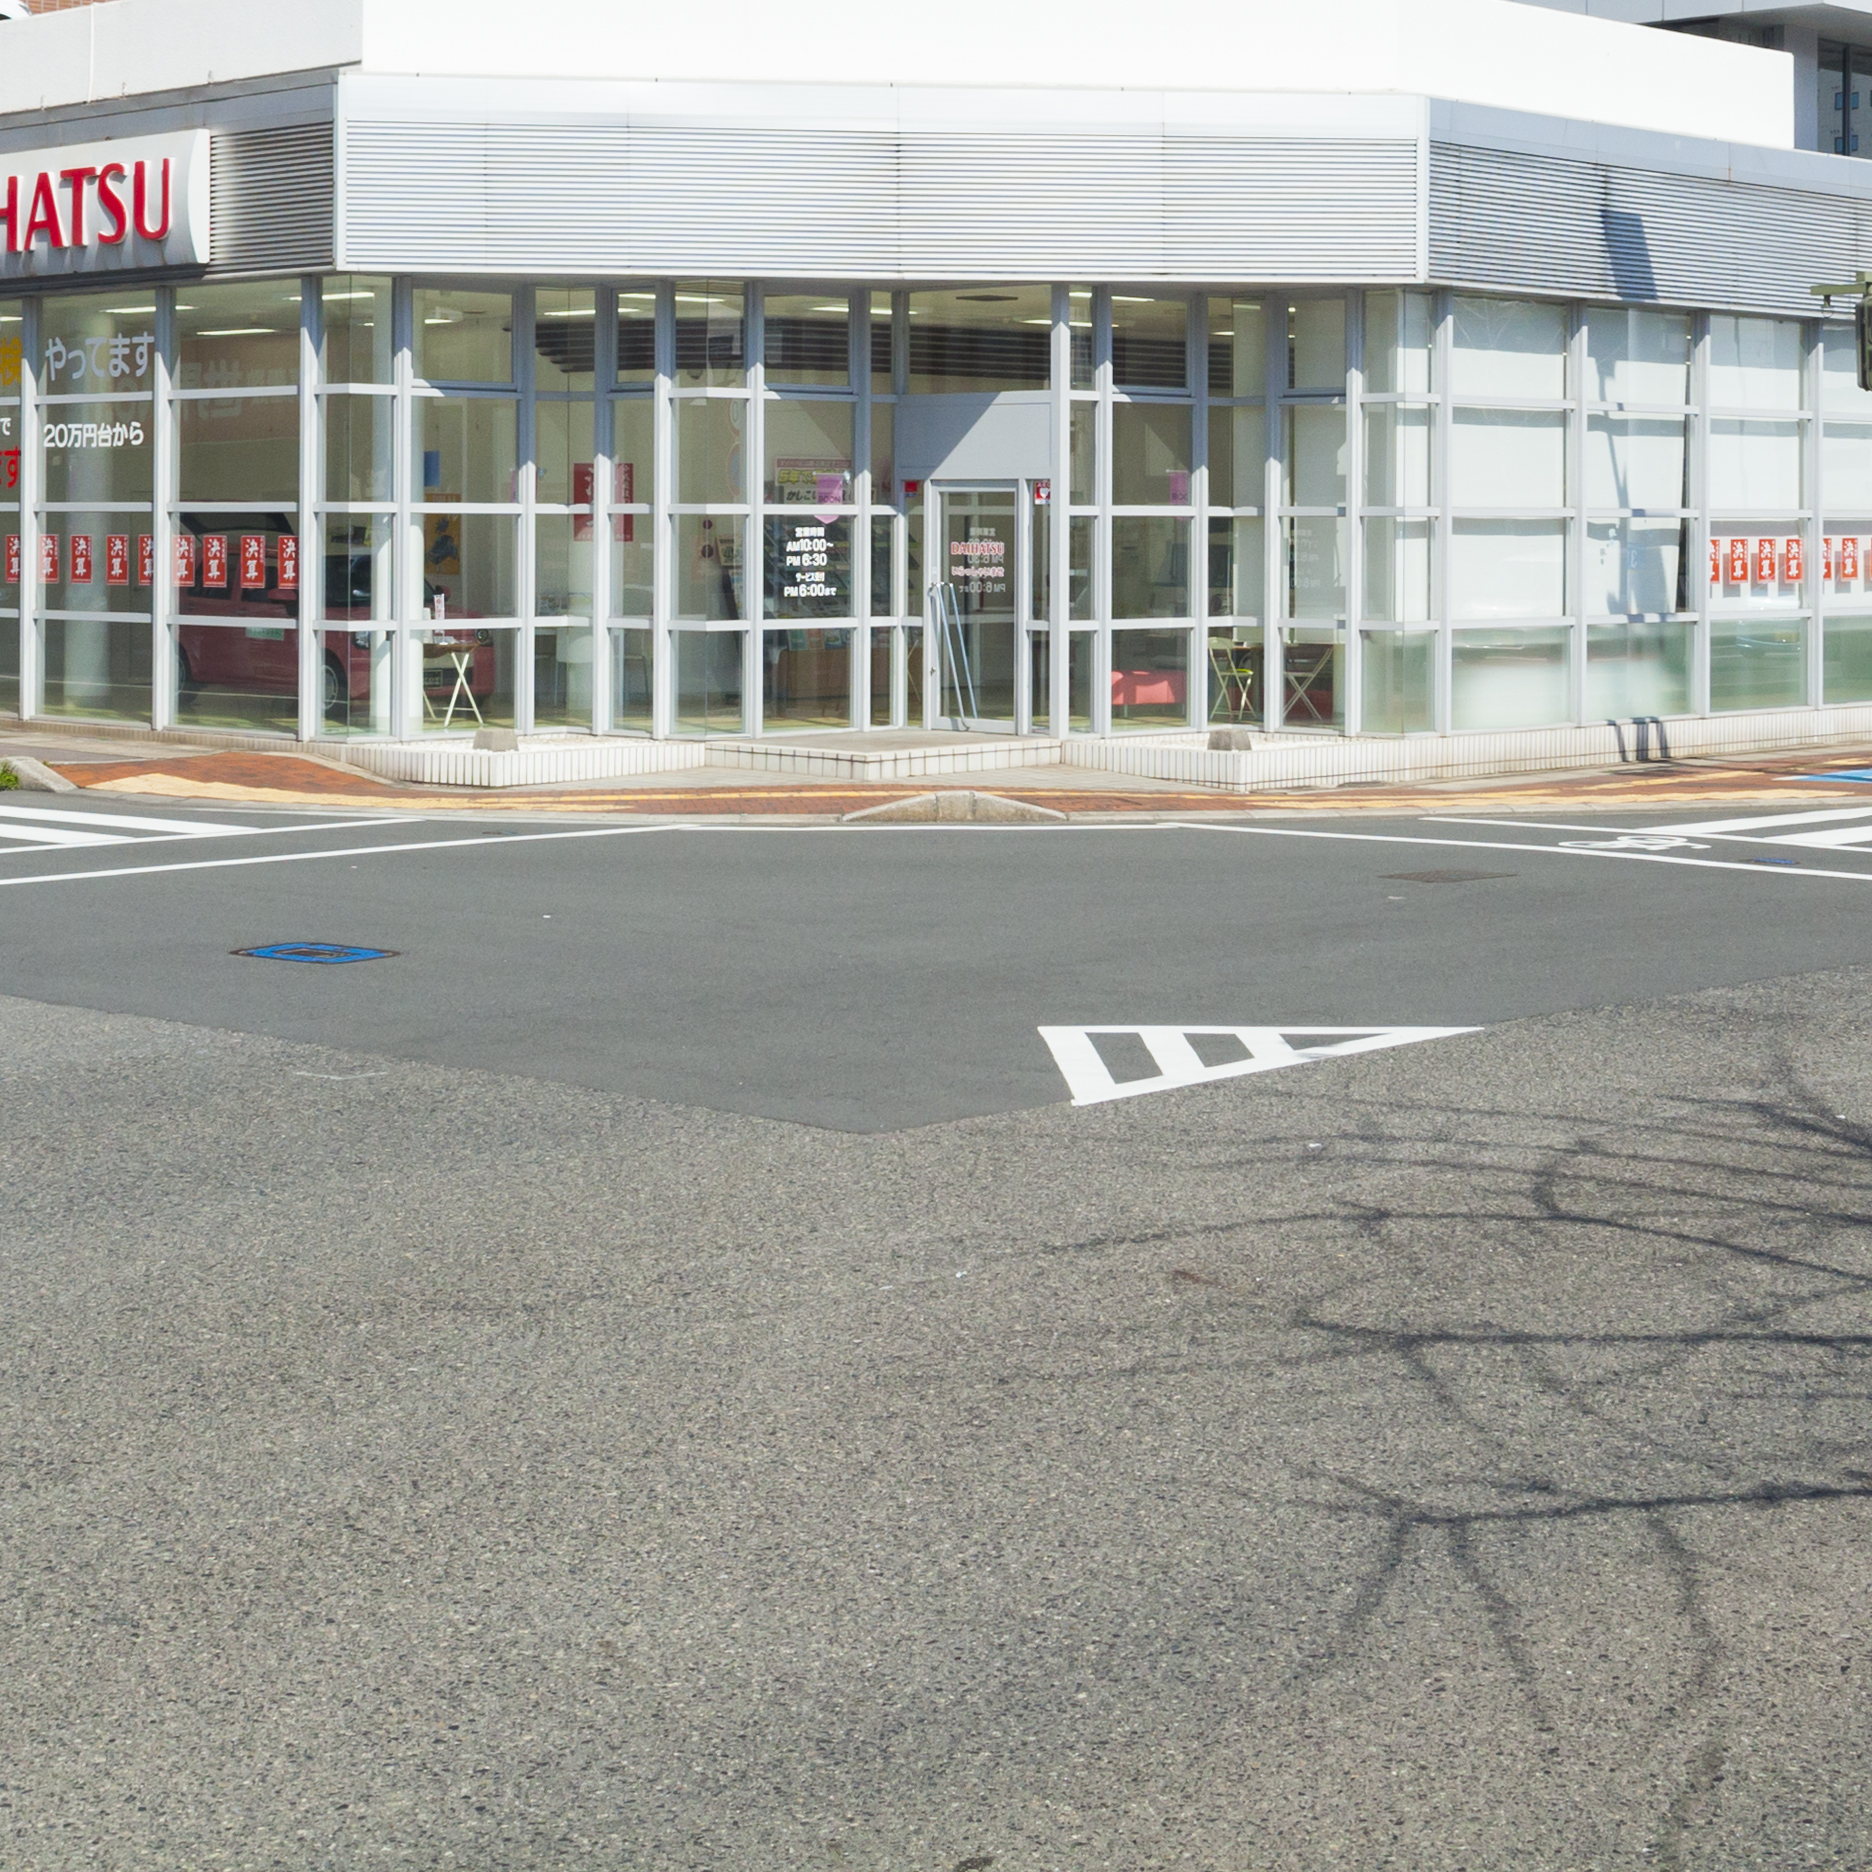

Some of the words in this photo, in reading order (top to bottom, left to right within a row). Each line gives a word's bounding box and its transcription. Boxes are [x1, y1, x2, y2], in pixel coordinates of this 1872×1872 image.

[45, 331, 154, 381] やってます
[44, 421, 144, 448] 20万円台から
[951, 542, 1005, 555] DAIHATSU
[786, 556, 801, 566] PM
[802, 553, 827, 566] 6:30
[784, 586, 798, 597] PM
